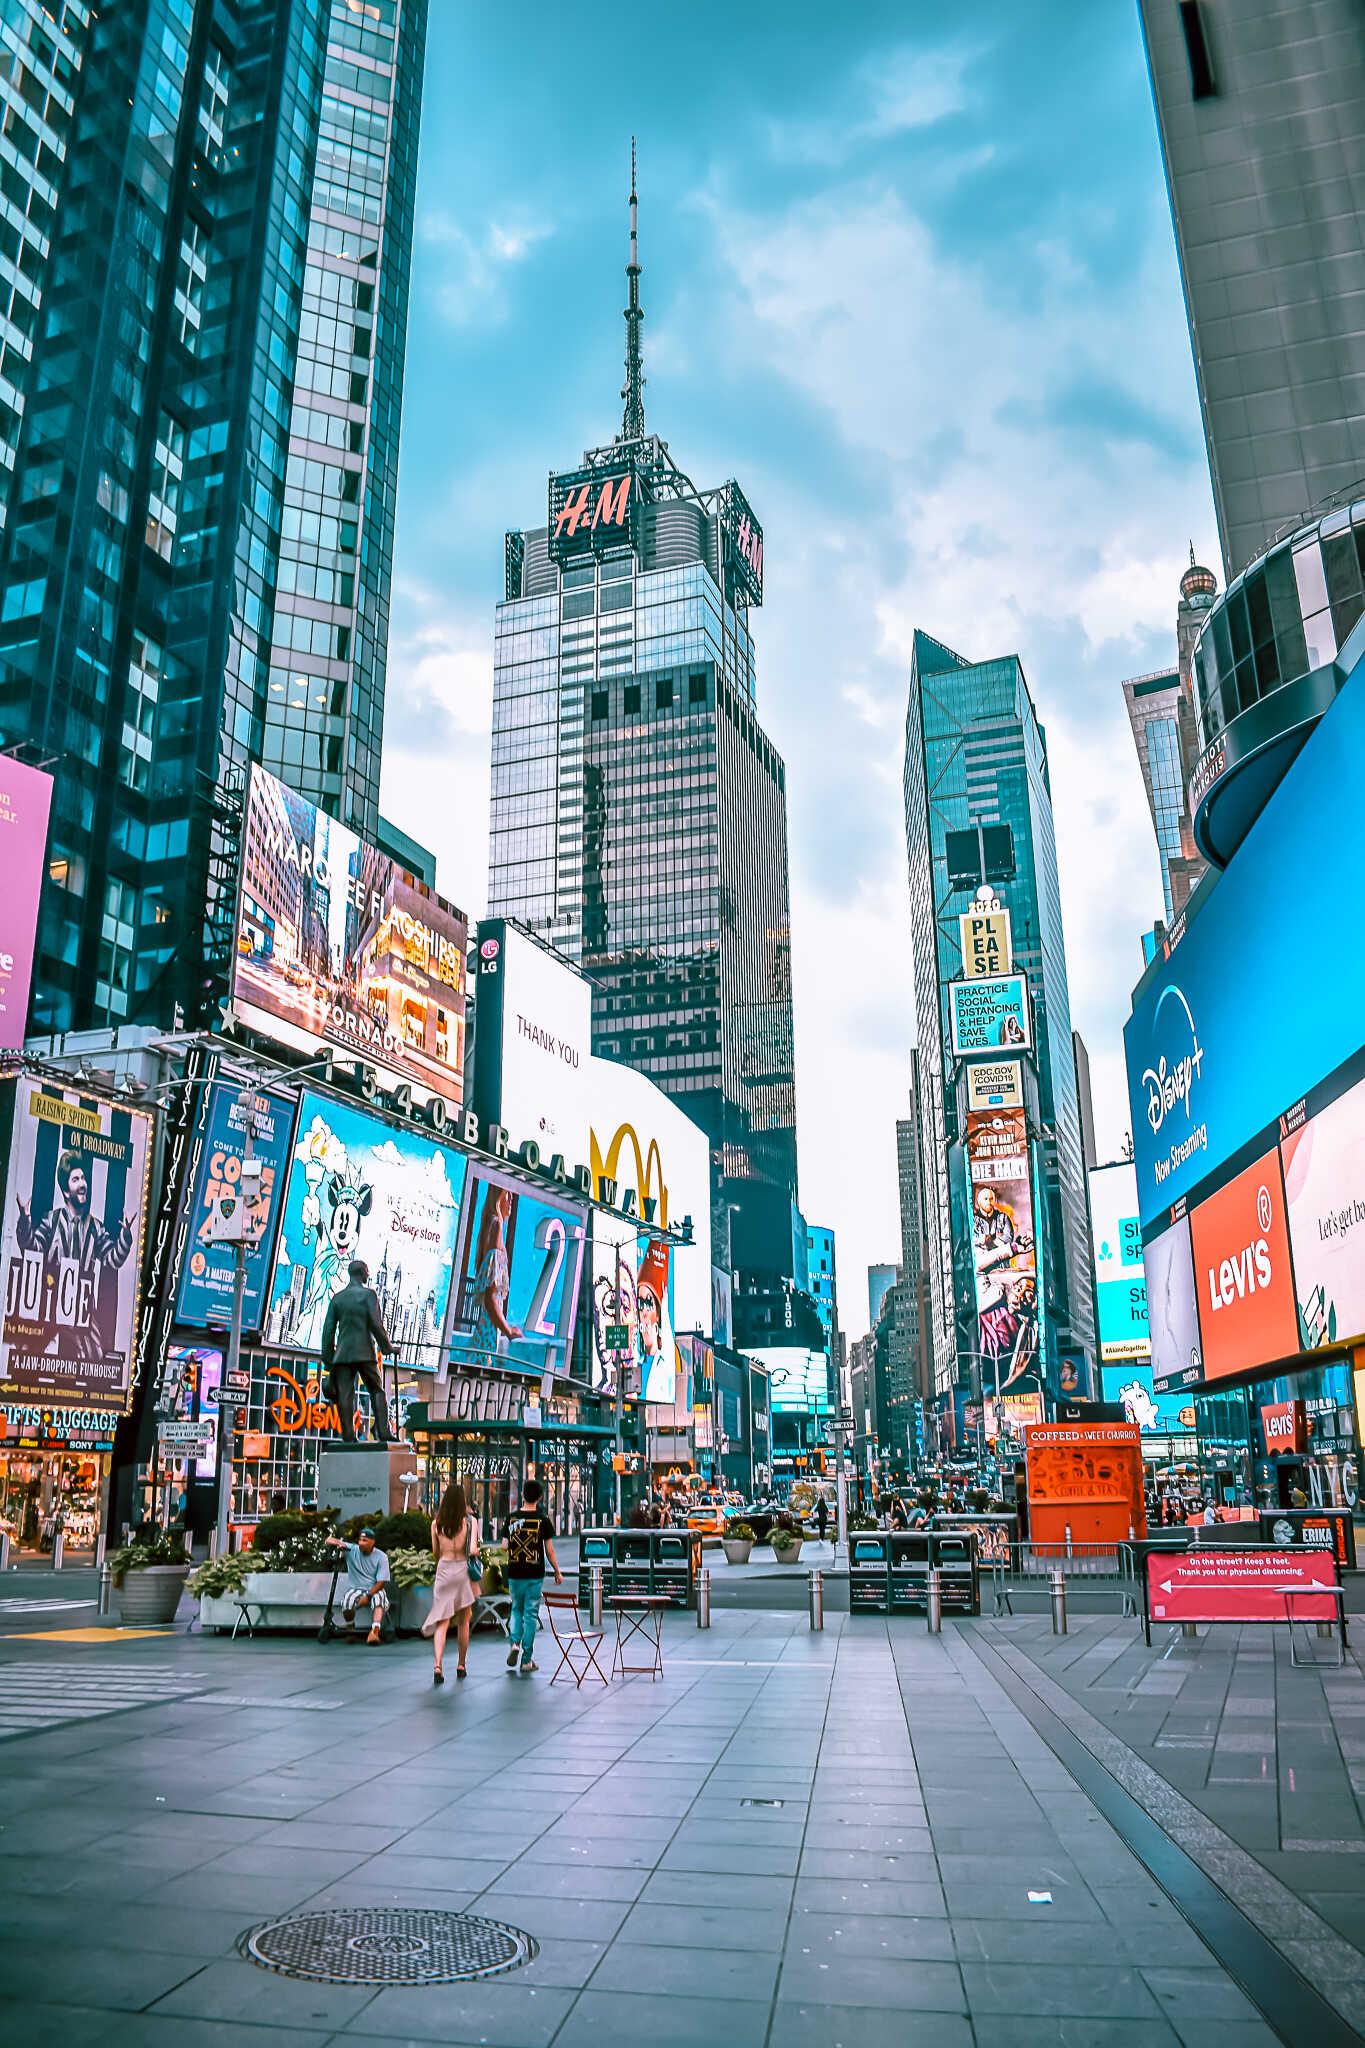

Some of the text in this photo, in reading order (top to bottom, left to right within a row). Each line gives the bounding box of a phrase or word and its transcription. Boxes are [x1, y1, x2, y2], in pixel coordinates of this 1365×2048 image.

[554, 475, 631, 538] H&M
[737, 513, 763, 581] H&M
[1193, 733, 1227, 786] MARRIOTT
[1195, 756, 1224, 801] MARQUIS
[264, 830, 463, 967] MARQEE FLAGSHIPS
[968, 899, 1001, 914] 2020
[971, 918, 997, 936] PL
[973, 937, 1000, 954] EA
[481, 961, 497, 974] LG
[974, 955, 1000, 974] SE
[957, 983, 1009, 998] PRACTICE
[957, 996, 995, 1008] SOCIAL
[958, 1002, 1021, 1018] DISTANCING
[959, 1015, 995, 1027] & HELP
[319, 997, 405, 1056] VORNADO
[959, 1027, 987, 1037] SAVE
[516, 1014, 579, 1069] THANK YOU
[960, 1036, 991, 1047] LIVES.
[973, 1066, 1013, 1077] CDC.GOV
[974, 1074, 1014, 1084] /COVID19
[179, 1051, 199, 1126] MAC
[199, 1056, 217, 1130] MAC
[36, 1098, 96, 1130] RAISING SPIRITS
[71, 1131, 125, 1160] ON BROADWAY!
[213, 1140, 233, 1152] COME
[270, 1159, 277, 1167] AT
[1155, 1124, 1208, 1185] Now Streaming
[164, 1134, 184, 1211] MAC
[184, 1138, 202, 1214] MAC
[460, 1110, 657, 1222] BROADWAY
[972, 1162, 992, 1179] DIE
[420, 1227, 440, 1242] store
[1319, 1209, 1338, 1240] Let's
[1338, 1207, 1352, 1237] get
[148, 1220, 169, 1298] MAC
[168, 1223, 187, 1300] MAC
[535, 1217, 586, 1340] 21
[785, 1294, 793, 1328] 1500
[133, 1306, 153, 1387] MAC
[153, 1309, 172, 1389] MAC
[1105, 1344, 1147, 1354] #AloneTogether
[21, 1356, 77, 1375] JAW-DROPPING
[230, 1393, 243, 1401] WAY
[446, 1376, 529, 1421] FOREVER
[52, 1409, 118, 1431] LUGGAGE
[57, 1427, 71, 1439] NY
[70, 1441, 93, 1449] SONY
[1030, 1431, 1137, 1441] COFFEED SWEET CHURROS
[1337, 1440, 1347, 1448] YOU
[1309, 1461, 1356, 1507] NYC
[1302, 1528, 1333, 1542] ERIKA
[1335, 1517, 1346, 1559] CHICAGO
[1177, 1568, 1305, 1577] Thank you for physical distancing.
[1201, 1557, 1215, 1565] the
[1216, 1557, 1243, 1565] street?
[1244, 1557, 1264, 1567] Keep
[1266, 1557, 1271, 1565] 6
[1272, 1557, 1291, 1565] feet.
